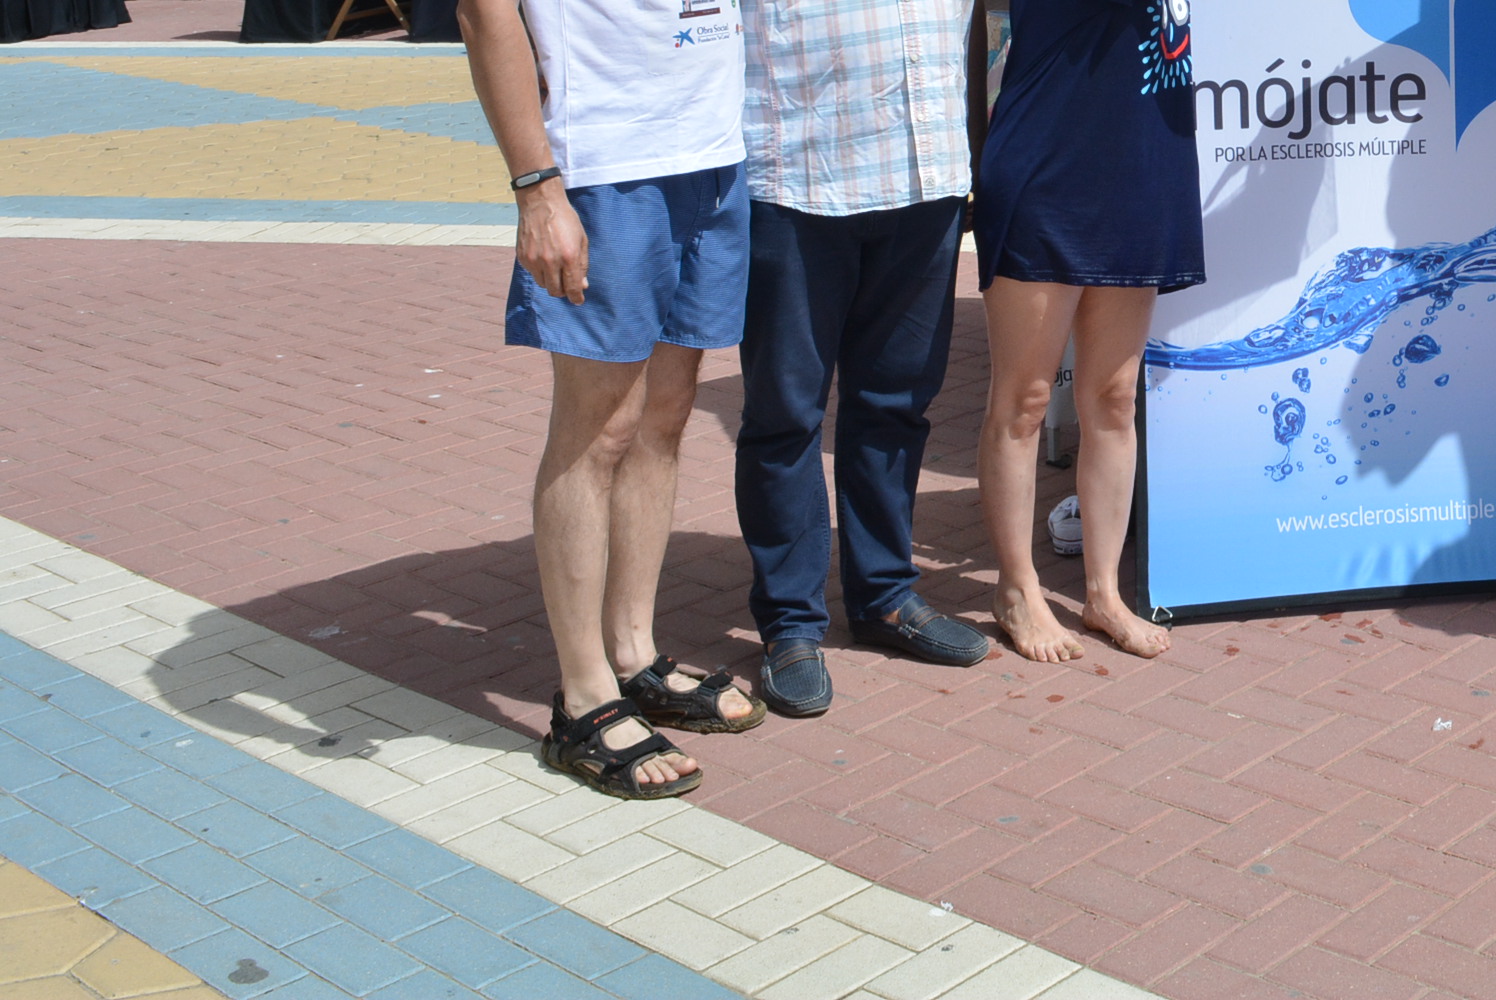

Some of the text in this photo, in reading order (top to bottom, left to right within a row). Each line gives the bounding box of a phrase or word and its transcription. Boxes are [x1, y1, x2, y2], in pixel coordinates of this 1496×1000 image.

[696, 26, 713, 35] Obra
[1192, 57, 1427, 141] mójate
[1214, 137, 1427, 163] POR LA ESCLEROSIS MÚLTIPLE
